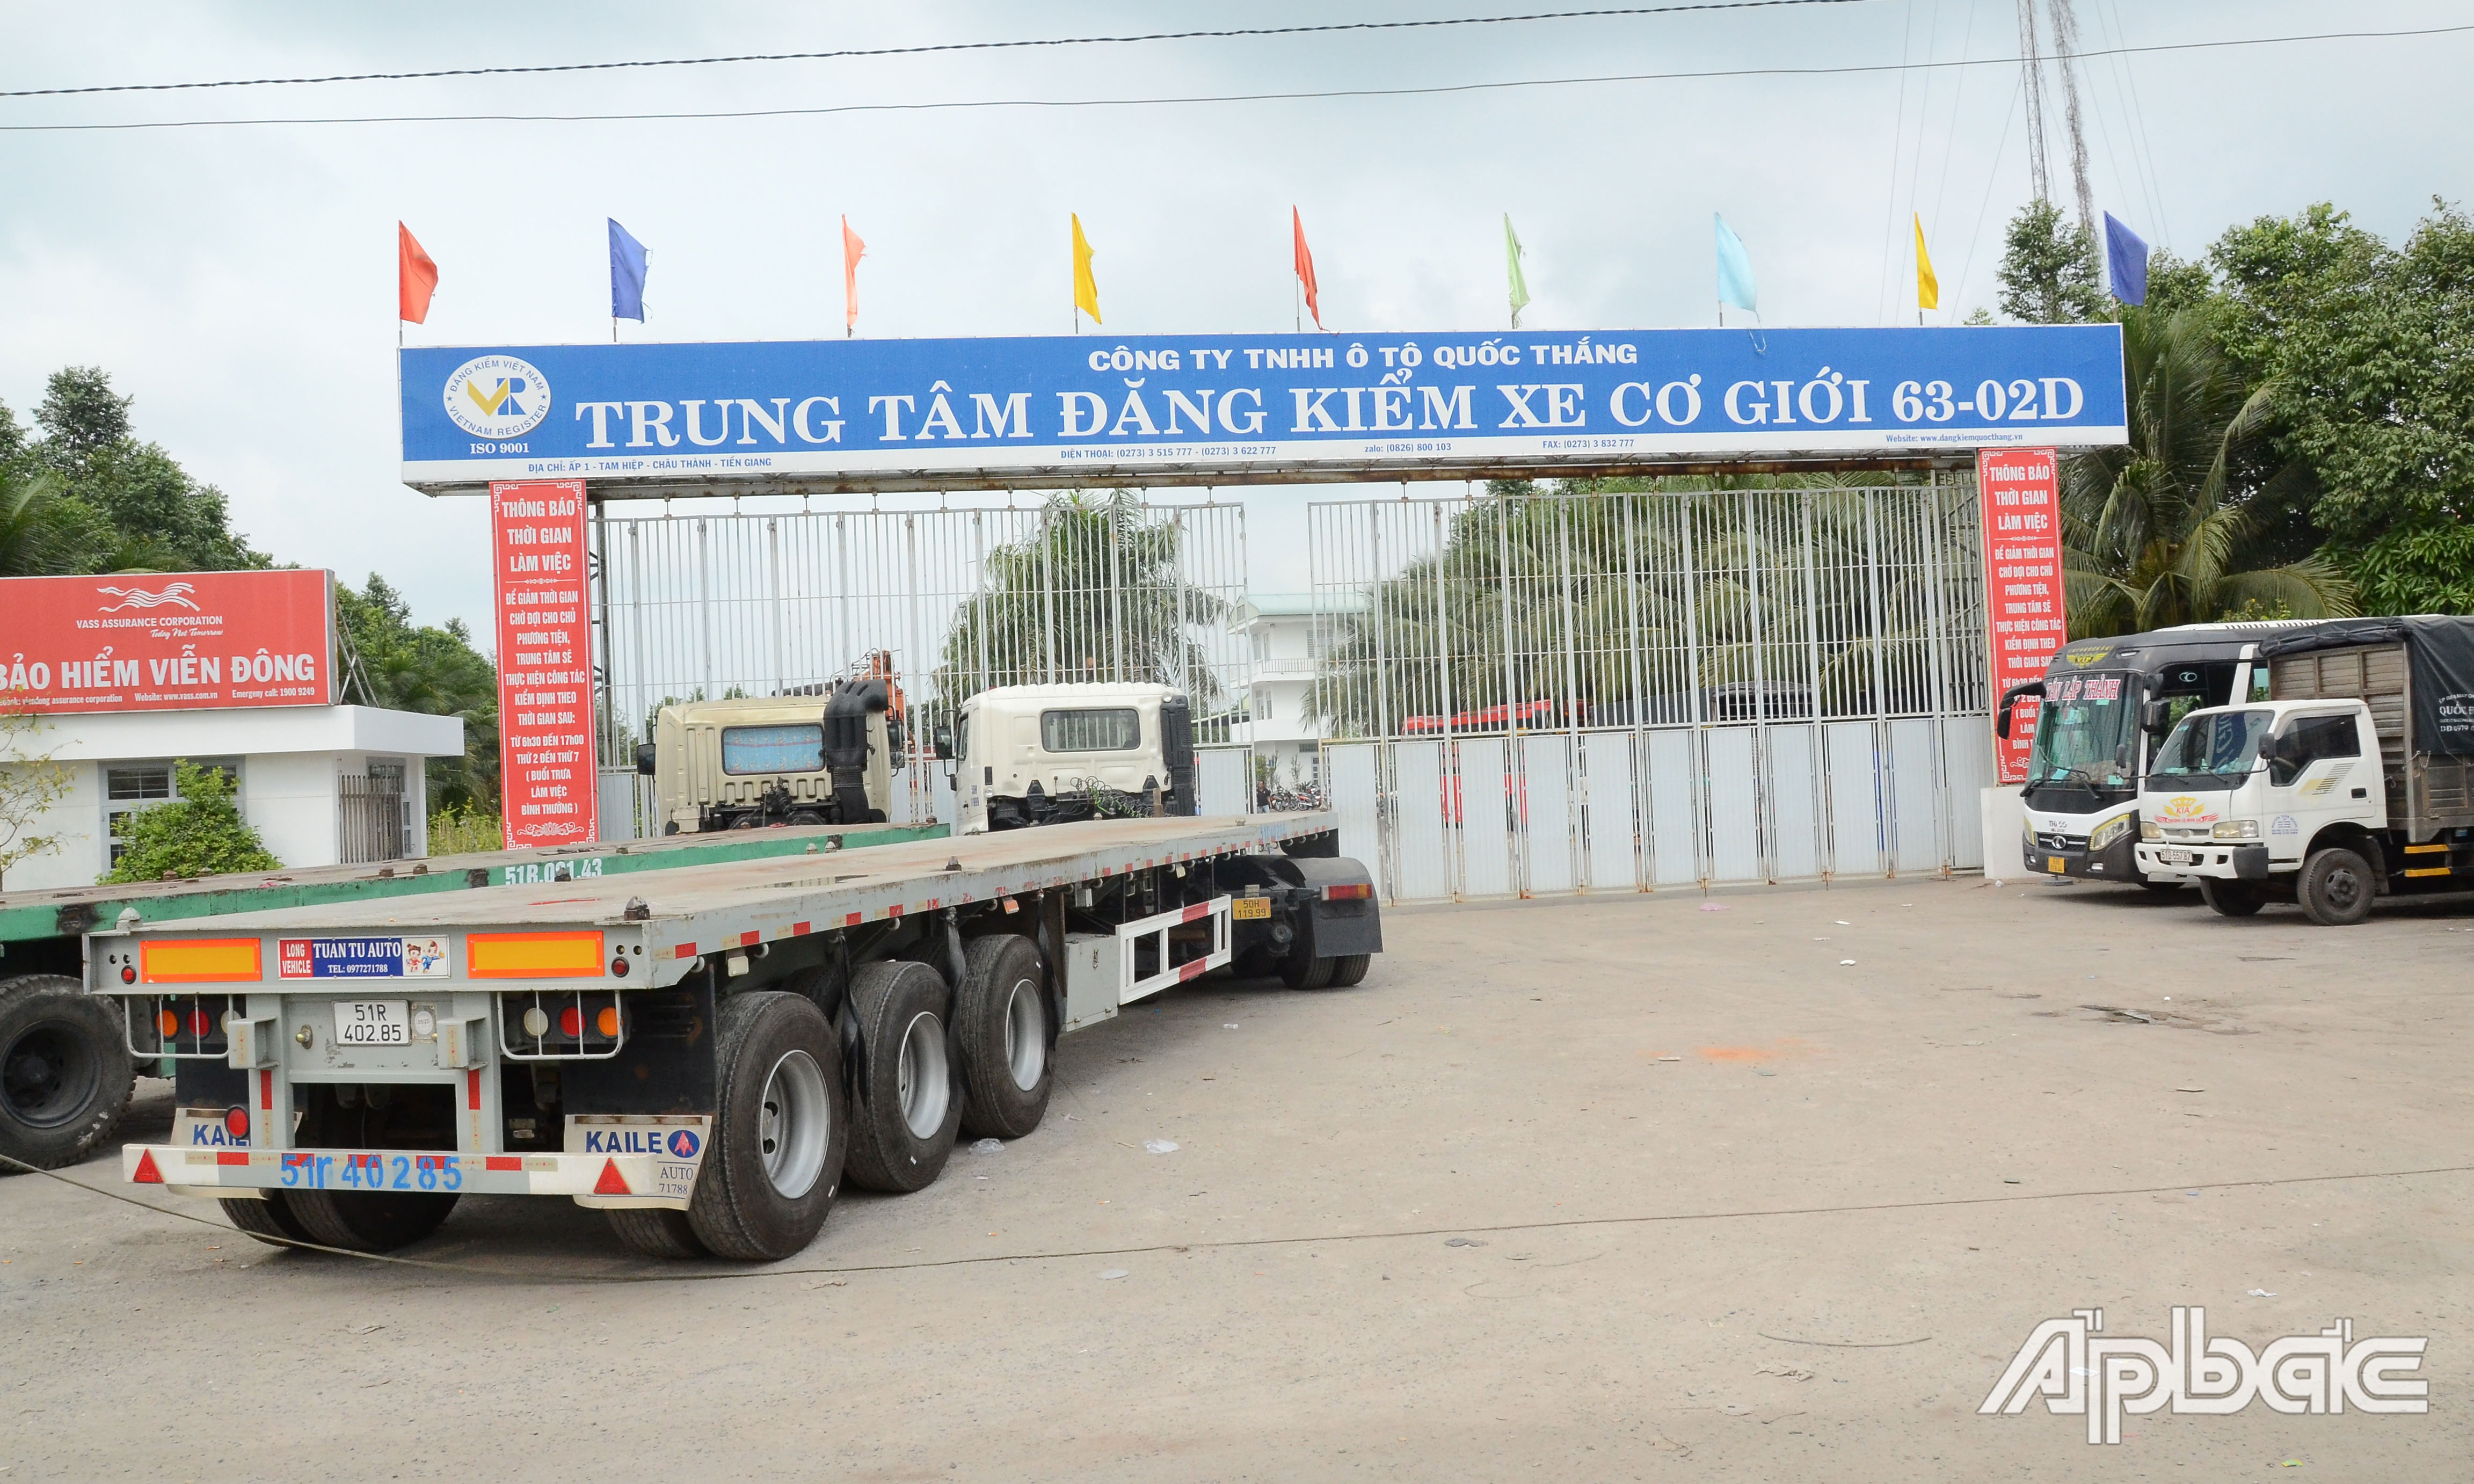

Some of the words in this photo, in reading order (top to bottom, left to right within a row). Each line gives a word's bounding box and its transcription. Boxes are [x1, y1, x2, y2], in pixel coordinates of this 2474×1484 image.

[1089, 345, 1180, 372] CÔNG
[1190, 349, 1233, 370] TY
[1244, 348, 1334, 369] TNHH
[1346, 342, 1368, 368] Ô
[1379, 341, 1423, 368] TÔ
[1434, 338, 1520, 370] QUỐC
[1530, 337, 1638, 365] THẮNG
[450, 368, 472, 392] ĐĂNG
[475, 357, 499, 370] KIỂM
[503, 361, 525, 372] VIỆT
[526, 370, 543, 390] NAM
[576, 396, 845, 448] TRUNG
[869, 380, 1034, 441] TÂM
[1056, 377, 1268, 437] ĐĂNG
[1290, 367, 1478, 432] KIỂM
[1497, 383, 1586, 428] XE
[1610, 373, 1702, 426] CƠ
[1724, 366, 1872, 425] GIỚI
[1892, 377, 2084, 423] 63-02D
[450, 406, 492, 435] VIETNAM
[498, 404, 546, 435] REGISTER
[1542, 440, 1561, 449] FAX:
[1563, 440, 1591, 449] (0273)
[1886, 434, 1918, 442] Website:
[1920, 433, 2022, 443] www.dangkiemquocthang.vn
[470, 443, 496, 454] ISO
[500, 443, 529, 453] 9001
[1060, 448, 1082, 460] ĐIỆN
[1084, 449, 1114, 460] THOẠI:
[1116, 447, 1145, 458] (0273)
[1148, 448, 1154, 456] 3
[1156, 447, 1173, 456] 515
[1175, 447, 1192, 456] 777
[1201, 446, 1230, 457] (0273)
[1233, 446, 1238, 455] 3
[1241, 446, 1257, 455] 622
[1260, 446, 1276, 455] 777
[1365, 445, 1384, 453] zalo:
[1386, 443, 1414, 453] (0826)
[1417, 443, 1433, 452] 800
[1436, 442, 1451, 452] 103
[528, 464, 544, 474] ĐỊA
[547, 460, 566, 472] CHỈ:
[569, 460, 581, 471] ẤP
[599, 461, 618, 470] TAM
[622, 459, 643, 471] HIỆP
[653, 459, 677, 469] CHÂU
[680, 457, 711, 468] THÀNH
[720, 456, 742, 467] TIỀN
[744, 458, 772, 467] GIANG
[1990, 464, 2025, 481] THÔNG
[2028, 463, 2049, 481] BÁO
[1995, 488, 2019, 505] THỜI
[2022, 490, 2047, 505] GIAN
[502, 498, 545, 518] THÔNG
[549, 497, 575, 517] BÁO
[1998, 513, 2021, 530] LÀM
[2024, 512, 2048, 532] VIỆC
[507, 525, 536, 544] THỜI
[541, 527, 571, 544] GIAN
[2039, 547, 2054, 558] GIAN
[510, 552, 538, 572] LÀM
[542, 551, 571, 574] VIỆC
[2026, 565, 2039, 577] CHO
[506, 588, 516, 605] ĐỂ
[518, 588, 538, 604] GIẢM
[540, 589, 557, 603] THỜI
[559, 591, 578, 603] GIAN
[2005, 602, 2026, 614] TRUNG
[2027, 600, 2041, 613] TÂM
[76, 620, 99, 629] VASS
[101, 618, 157, 628] ASSURANCE
[159, 616, 222, 627] CORPORATION
[510, 610, 525, 625] CHỜ
[527, 611, 540, 627] ĐỢI
[542, 611, 558, 624] CHO
[560, 607, 576, 623] CHỦ
[150, 629, 170, 639] Today
[189, 628, 223, 636] Tomorrow
[517, 631, 548, 645] PHƯƠNG
[2040, 637, 2055, 649] THEO
[61, 645, 140, 688] HIỂM
[149, 643, 220, 685] VIỄN
[231, 648, 315, 683] ĐÔNG
[516, 652, 541, 665] TRUNG
[543, 651, 560, 664] TÂM
[505, 672, 525, 688] THỰC
[527, 671, 545, 687] HIỆN
[547, 670, 569, 684] CÔNG
[570, 669, 585, 683] TÁC
[85, 694, 122, 703] corporation
[135, 693, 162, 701] Website:
[164, 692, 218, 700] www.vass.com.vn
[232, 689, 263, 699] Emergeny
[265, 688, 278, 697] call:
[280, 688, 296, 696] 1900
[298, 687, 315, 696] 9249
[515, 689, 535, 705] KIỂM
[536, 692, 555, 707] ĐỊNH
[557, 692, 576, 704] THEO
[518, 710, 535, 725] THỜI
[537, 712, 556, 725] GIAN
[558, 711, 575, 724] SAU:
[511, 735, 521, 747] TỪ
[522, 736, 541, 747] 6h30
[543, 733, 558, 746] ĐẾN
[560, 734, 584, 746] 17h00
[516, 752, 532, 764] THỨ
[540, 750, 556, 763] ĐẾN
[551, 768, 571, 780] TRƯA
[531, 785, 547, 798] LÀM
[550, 784, 567, 799] VIỆC
[521, 803, 540, 816] BÌNH
[542, 801, 573, 814] THƯỜNG
[1243, 900, 1259, 908] 50H
[1239, 908, 1266, 918] 119.99
[287, 943, 305, 958] LONG
[313, 943, 346, 958] TUAN
[348, 942, 366, 958] TU
[367, 942, 401, 957] AUTO
[282, 959, 310, 974] VEHICLE
[328, 965, 346, 973] TEL:
[346, 964, 388, 973] 0977271788
[355, 1005, 386, 1021] 51R
[345, 1024, 402, 1042] 402.85
[586, 1131, 663, 1154] KAILE
[281, 1154, 333, 1189] 51r
[341, 1155, 462, 1190] 40285
[660, 1167, 693, 1180] AUTO
